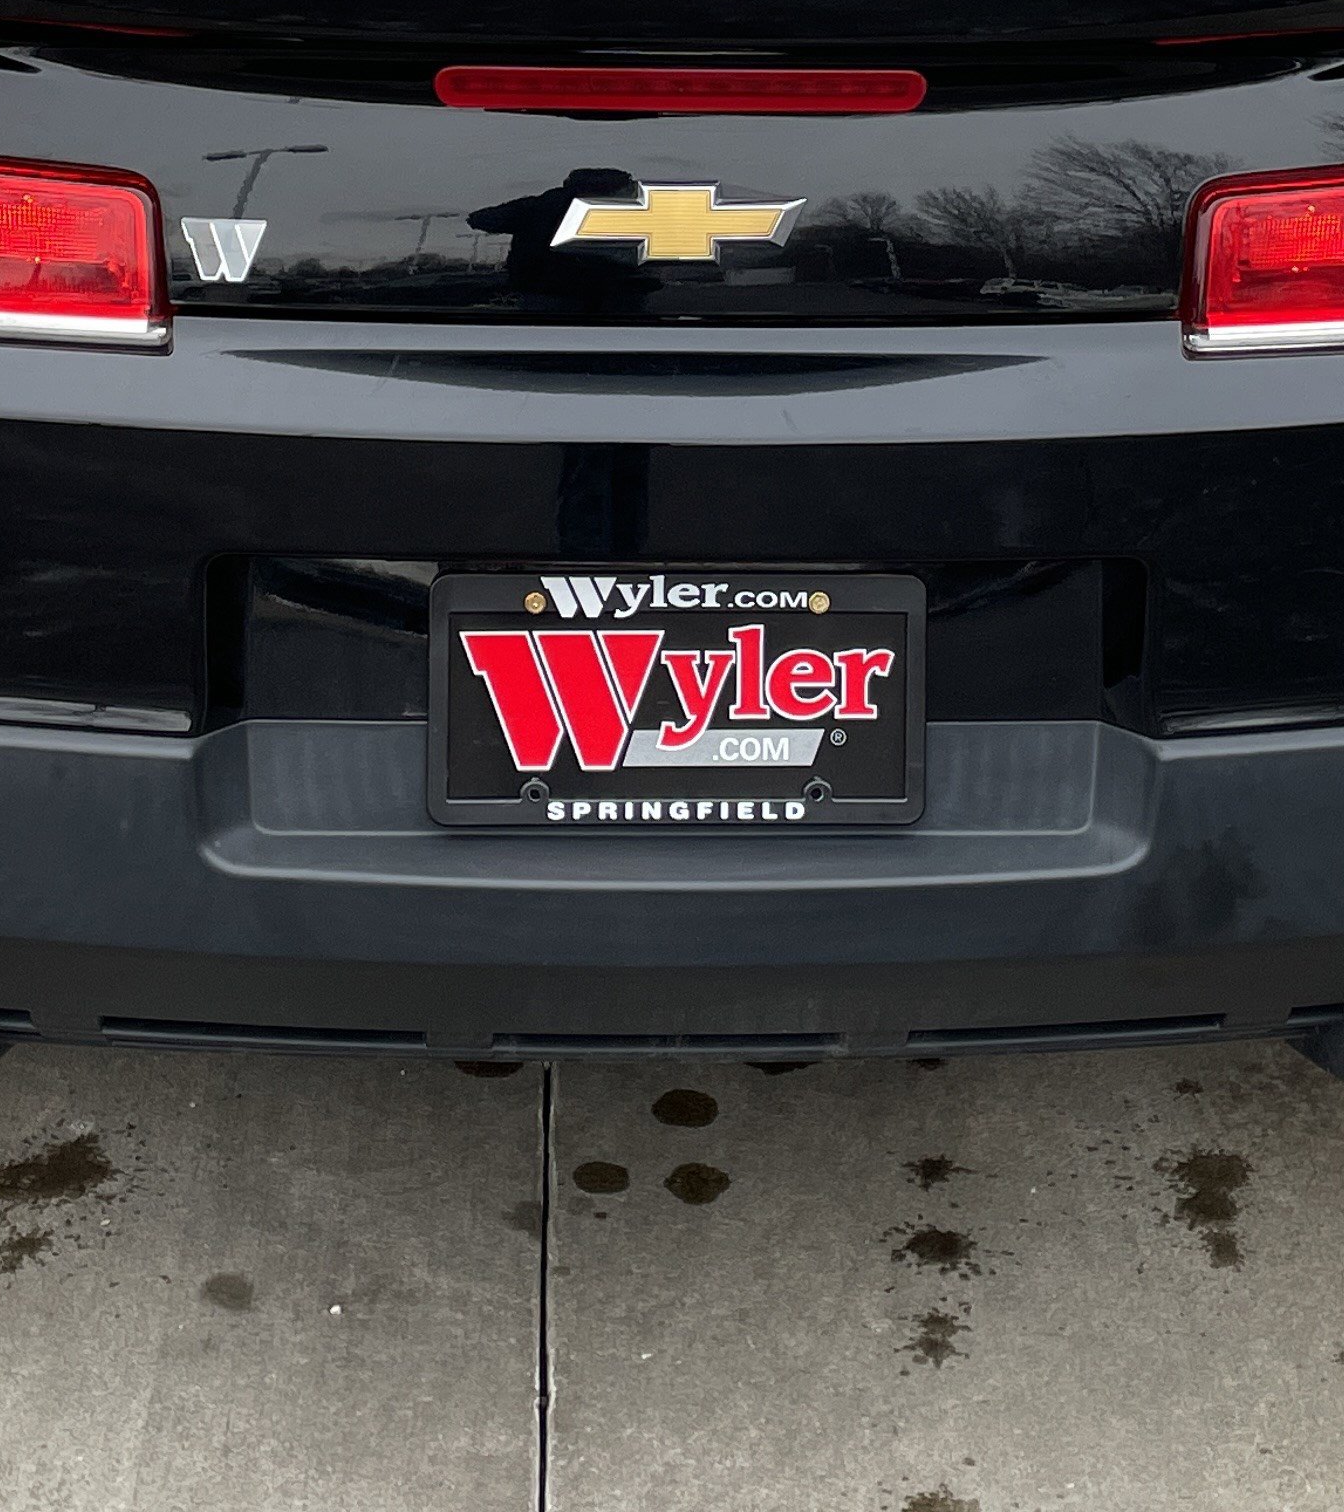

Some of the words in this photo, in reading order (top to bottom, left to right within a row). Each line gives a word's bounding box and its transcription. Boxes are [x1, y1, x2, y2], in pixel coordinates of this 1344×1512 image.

[459, 624, 895, 771] Wyler
[711, 738, 790, 761] .COM
[546, 801, 806, 821] SPRINGFIELD
